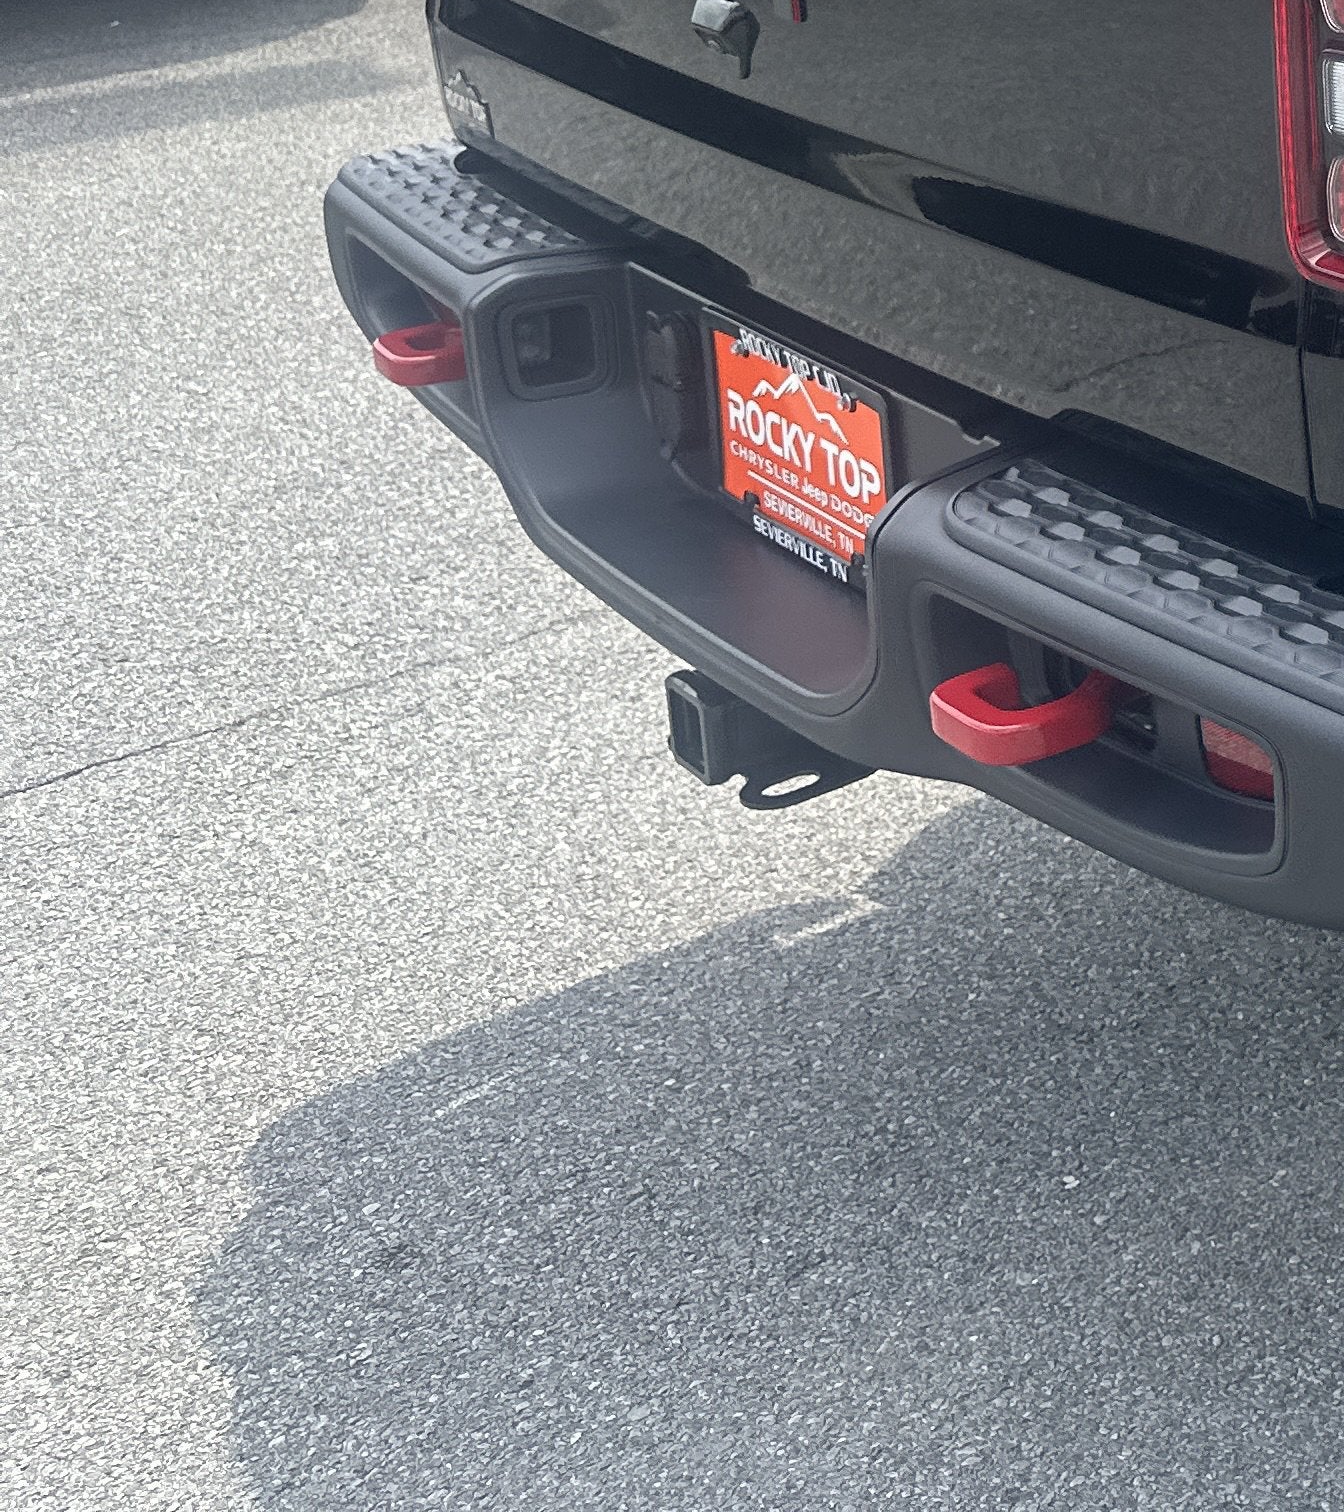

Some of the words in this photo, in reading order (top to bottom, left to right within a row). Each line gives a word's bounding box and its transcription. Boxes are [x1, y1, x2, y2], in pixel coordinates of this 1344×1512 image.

[727, 388, 816, 473] ROCKY
[820, 439, 881, 504] TOP
[729, 440, 799, 490] CHRYSLER
[802, 476, 829, 507] Jeep
[831, 493, 875, 528] DODG
[753, 514, 828, 573] SEVIERVILLE,
[830, 557, 848, 583] TN
[838, 531, 854, 555] TN
